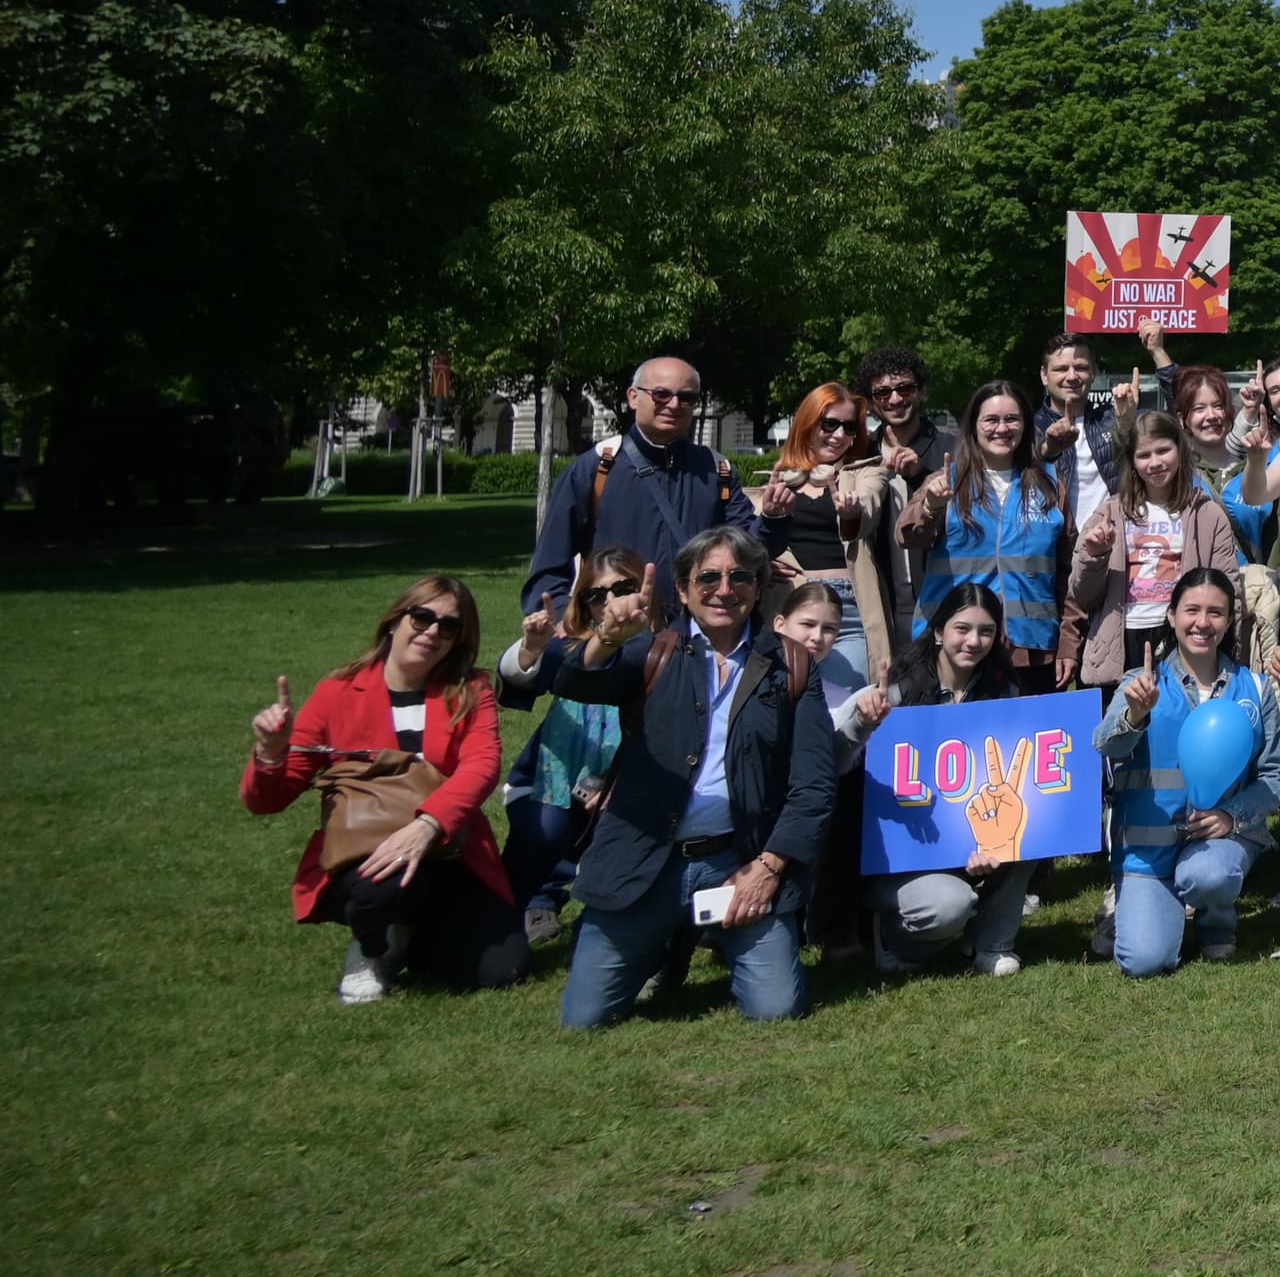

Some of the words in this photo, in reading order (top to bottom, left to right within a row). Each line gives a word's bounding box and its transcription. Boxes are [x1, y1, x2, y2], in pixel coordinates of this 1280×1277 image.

[1120, 283, 1139, 302] NO
[1143, 283, 1176, 302] WAR
[1102, 309, 1137, 329] JUST
